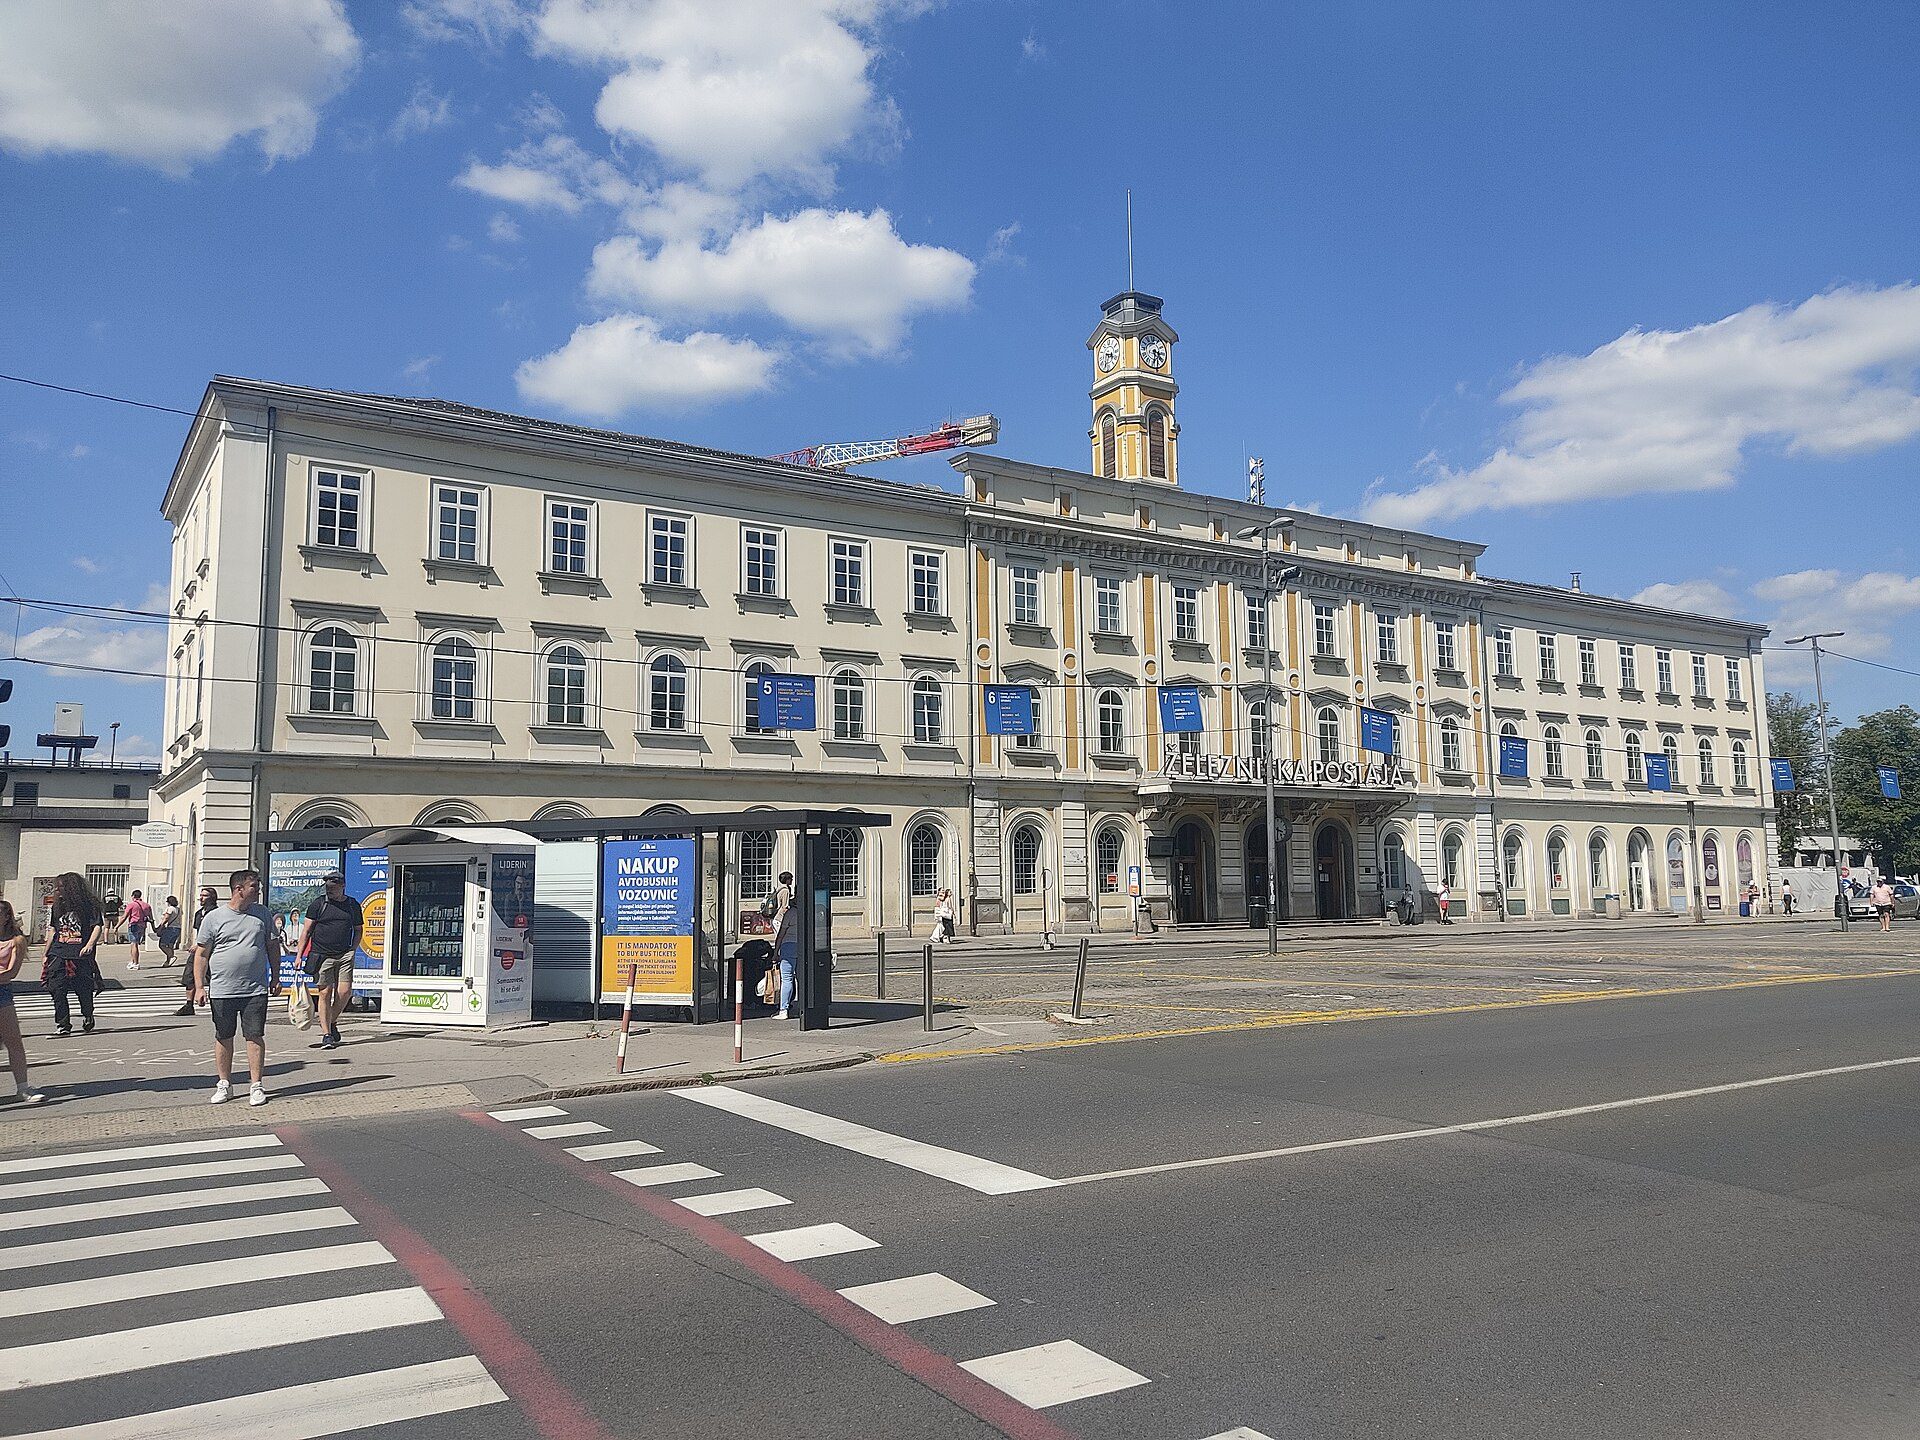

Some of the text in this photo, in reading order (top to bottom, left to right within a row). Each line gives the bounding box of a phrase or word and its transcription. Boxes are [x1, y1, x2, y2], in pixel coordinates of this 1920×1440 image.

[763, 680, 773, 695] 5
[988, 691, 996, 704] 6
[1162, 692, 1169, 705] 7
[1363, 713, 1369, 724] 8
[1501, 741, 1507, 751] 9
[1164, 743, 1405, 786] ŽELEZNIKA POSTAJA
[1646, 758, 1653, 768] 10
[1771, 762, 1777, 771] 11
[272, 859, 338, 869] DRAGI UPOKOJENCI,
[500, 860, 527, 869] LIDERIN
[618, 857, 679, 874] NAKUP
[272, 877, 326, 887] RAZIŠČITE SLOVE
[618, 877, 679, 887] AVTOBUSNIH
[618, 889, 678, 901] VOZOVNIC
[367, 919, 386, 927] TUKA
[418, 996, 431, 1005] VIVA
[432, 992, 449, 1011] 24
